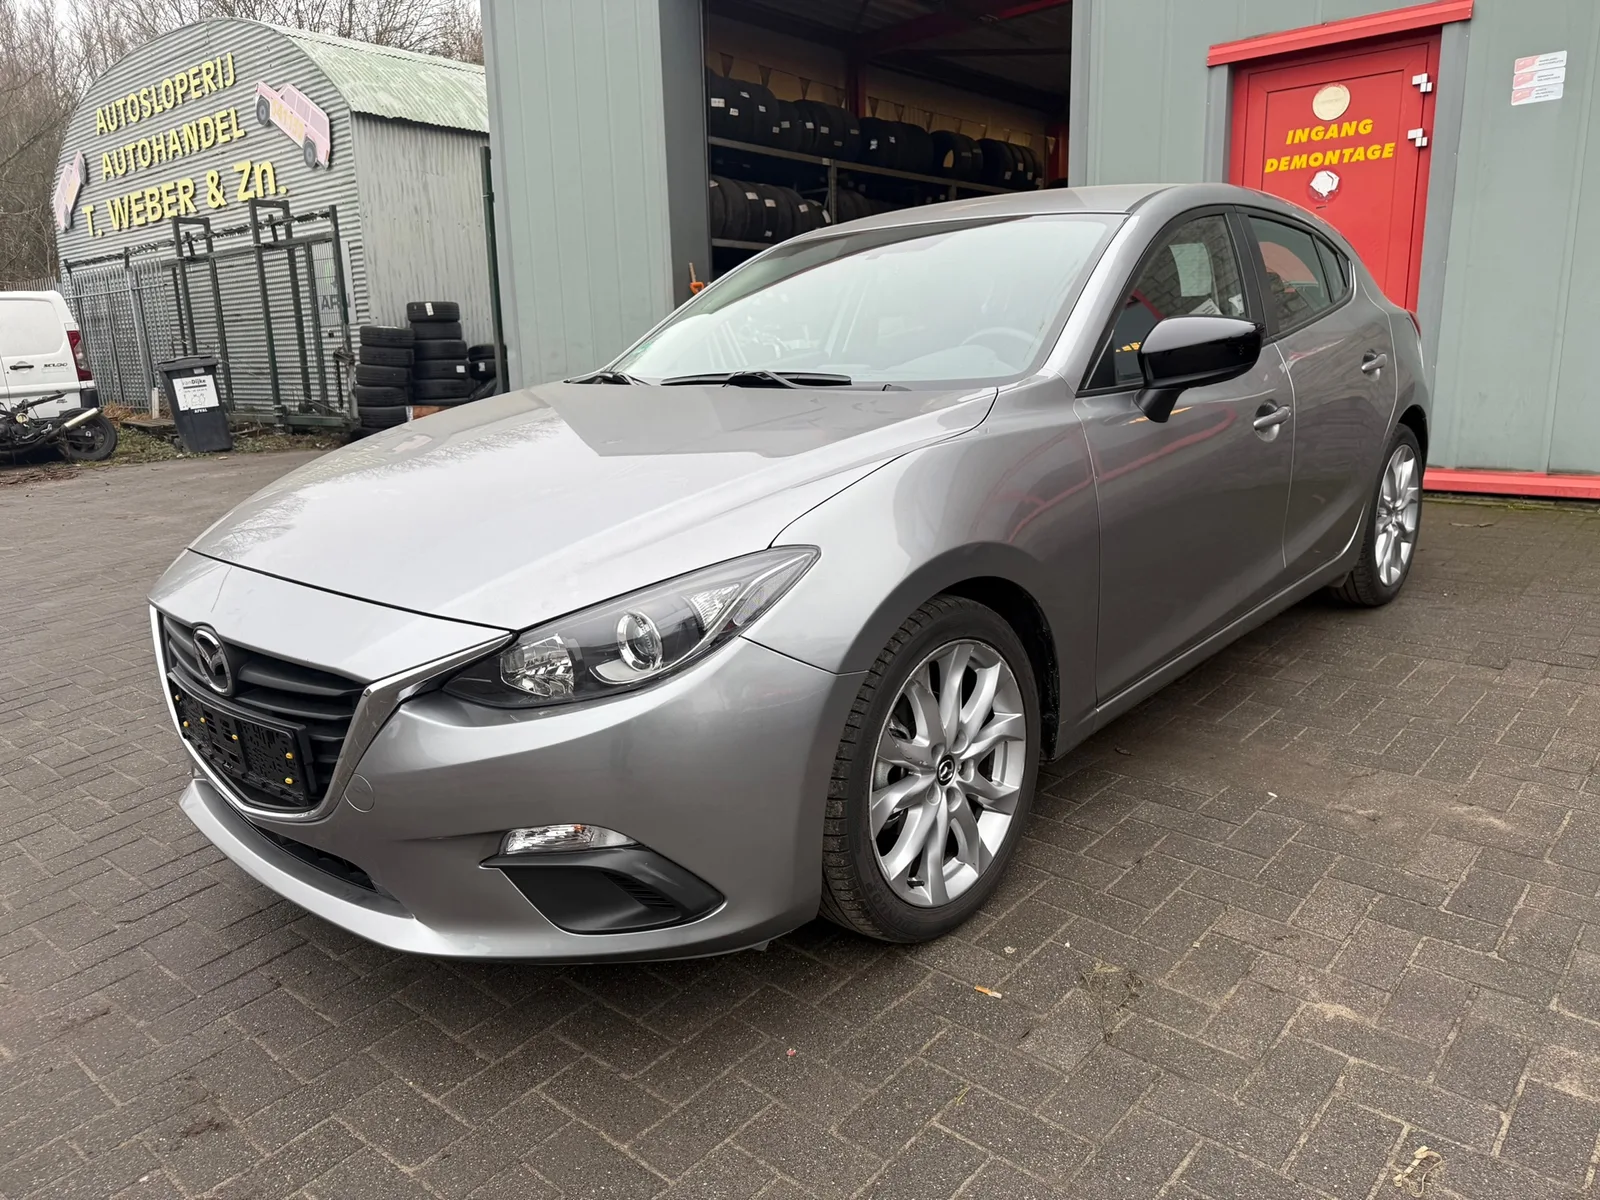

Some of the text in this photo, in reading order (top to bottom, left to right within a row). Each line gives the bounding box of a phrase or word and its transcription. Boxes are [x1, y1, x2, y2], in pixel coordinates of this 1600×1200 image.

[96, 52, 235, 135] AUTOSLOPERIJ
[101, 107, 245, 180] AUTOHANDEL
[1264, 142, 1396, 173] DEMONTAGE
[1285, 118, 1373, 145] INGANG
[82, 160, 288, 237] T. WEBER & Zn.
